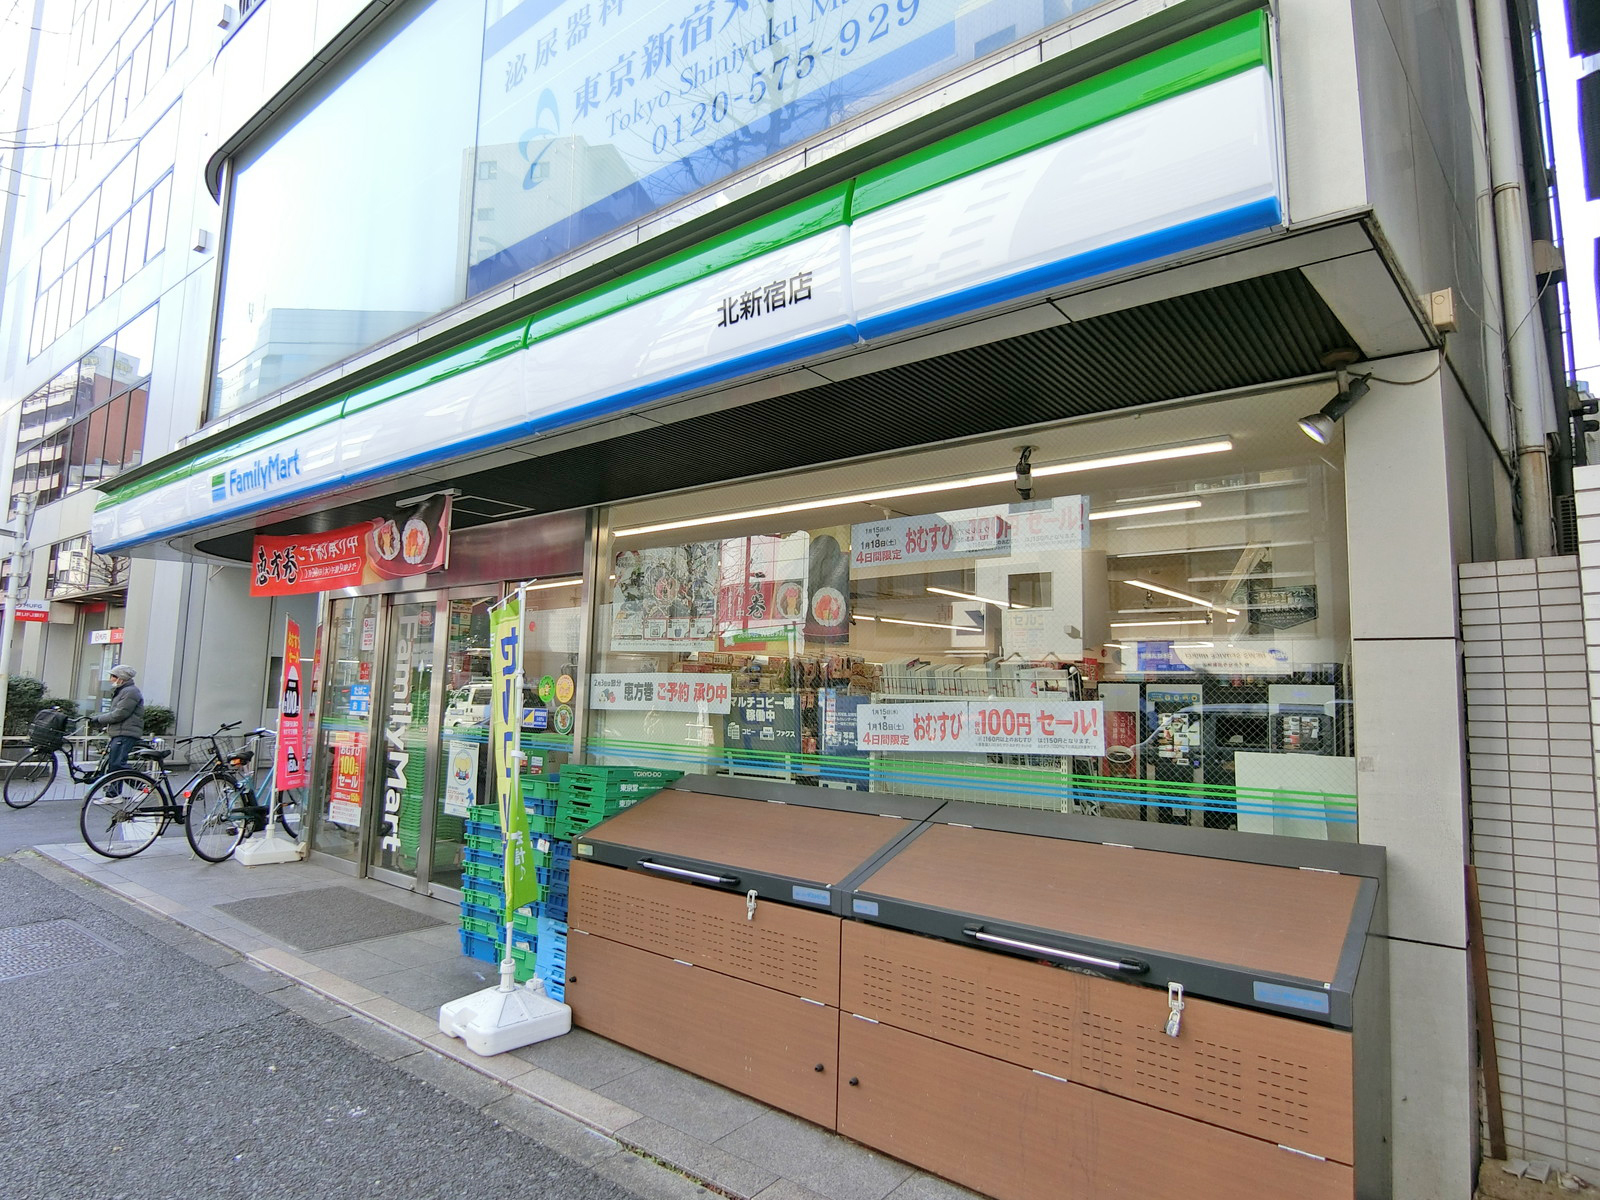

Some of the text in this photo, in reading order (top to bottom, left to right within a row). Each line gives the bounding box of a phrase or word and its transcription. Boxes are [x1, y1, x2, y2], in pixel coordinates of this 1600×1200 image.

[605, 0, 852, 138] Tokyo Shinjyuku M
[717, 271, 813, 329] 北新宿店
[229, 449, 300, 496] FamilyMart
[861, 539, 897, 550] 1月18日(土)
[855, 549, 902, 564] 4日間限定
[624, 682, 727, 704] 恵方巻 ご予約 承り中
[742, 728, 757, 736] コピー
[867, 720, 905, 732] 1月18日(土)
[913, 711, 963, 742] おむすび
[978, 708, 1032, 736] 100円
[1036, 707, 1098, 737] セール!
[382, 615, 418, 853] FamilyMart
[862, 732, 910, 746] 4日間限定
[340, 746, 361, 756] おむすび
[338, 774, 359, 789] セール
